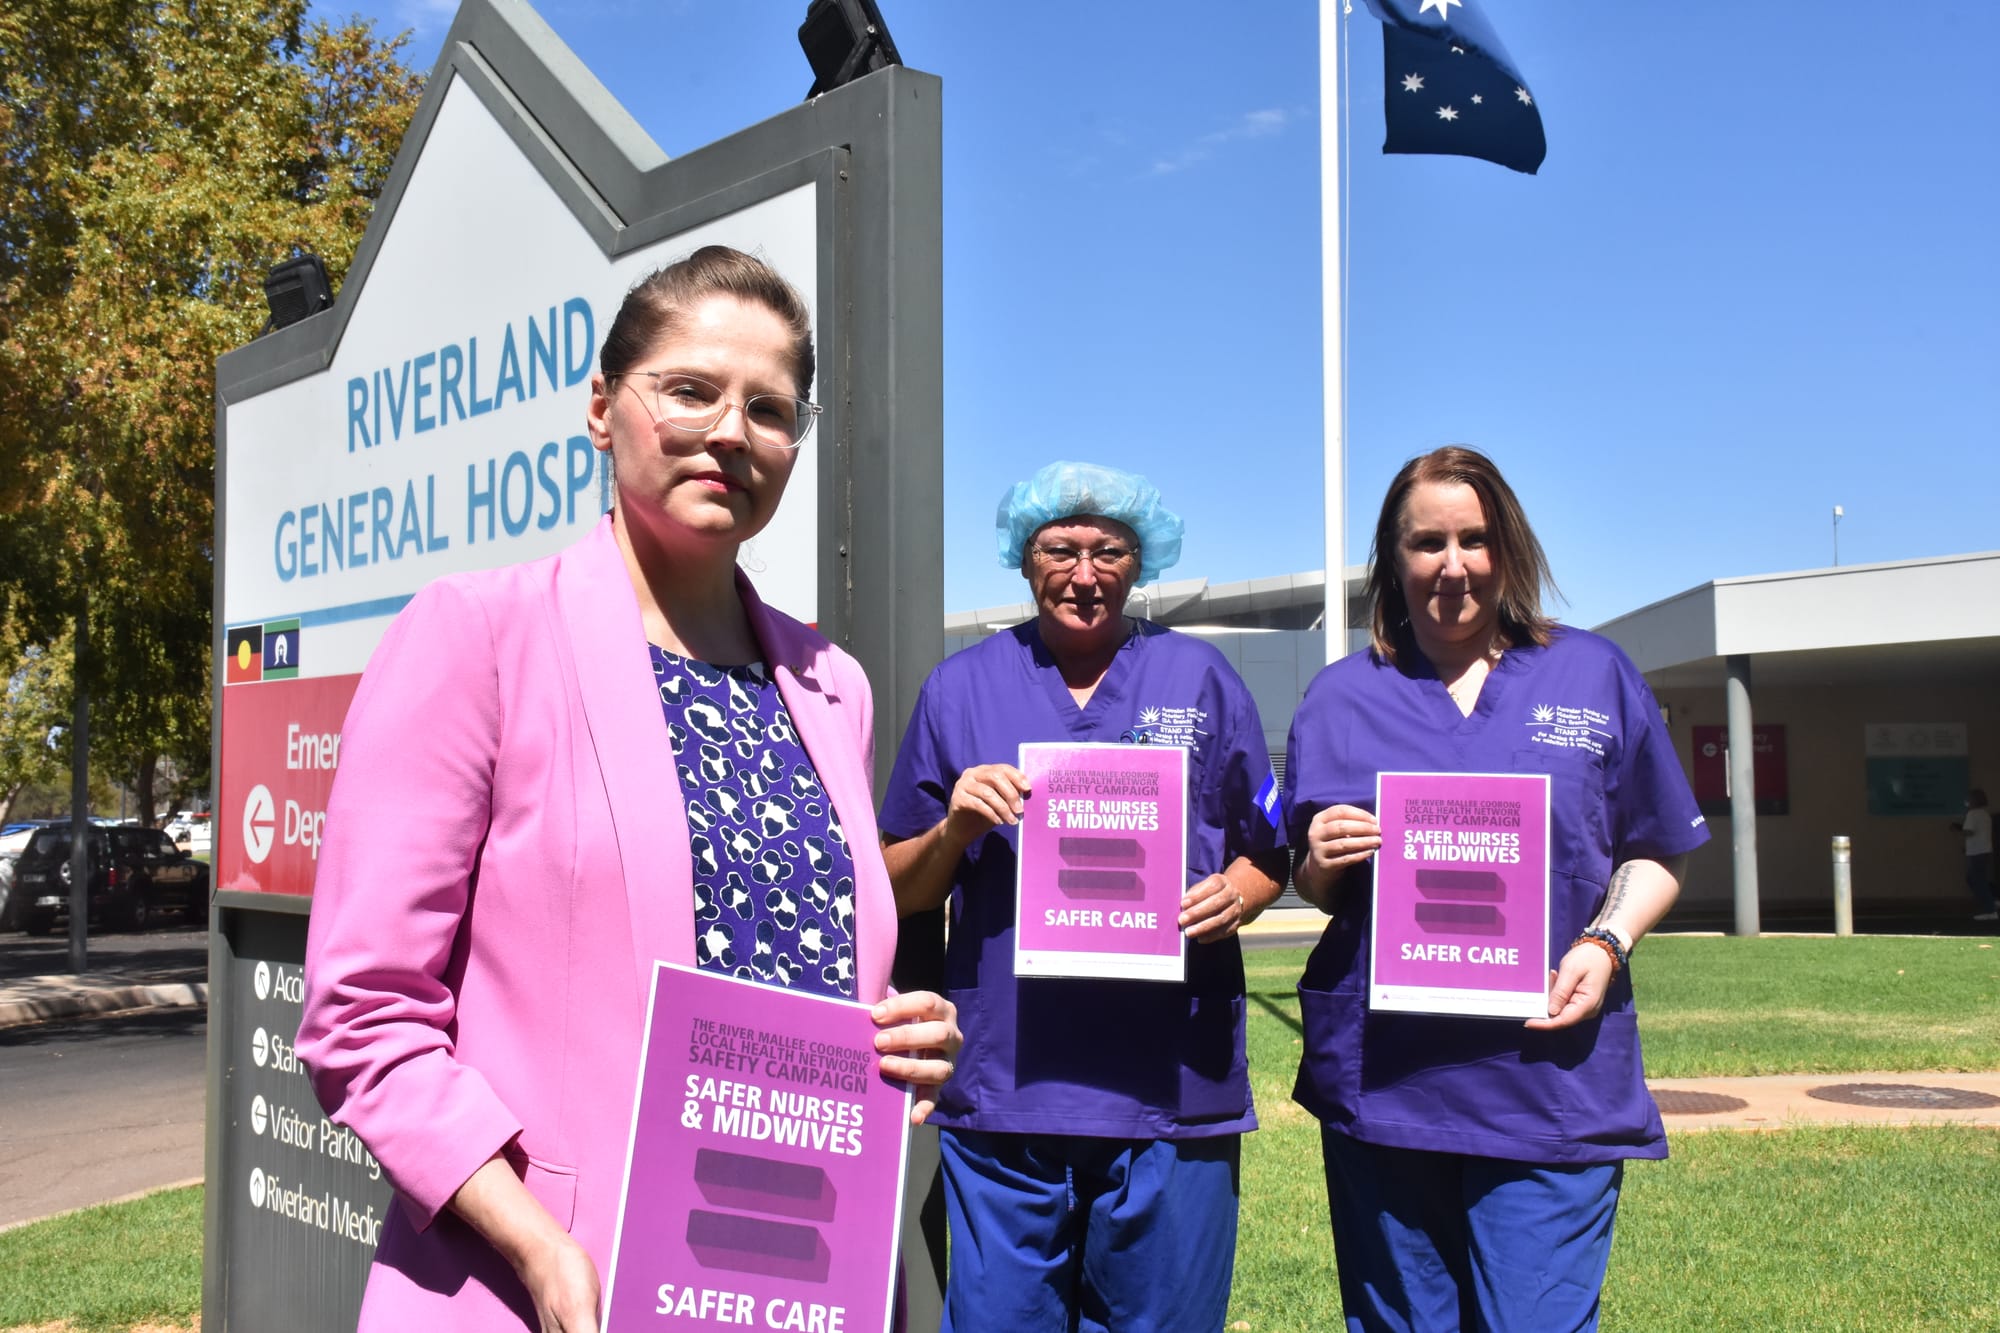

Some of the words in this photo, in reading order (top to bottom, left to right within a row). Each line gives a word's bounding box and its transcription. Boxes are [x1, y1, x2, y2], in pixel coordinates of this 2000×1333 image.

[347, 297, 595, 453] RIVERLAND
[275, 475, 449, 583] GENERAL
[287, 723, 341, 769] Emer
[1048, 776, 1075, 784] LOCAL
[1080, 777, 1111, 785] HEALTH
[1115, 778, 1158, 786] NETWORK
[1048, 784, 1090, 794] SAFETY
[1095, 785, 1159, 796] CAMPAIGN
[1047, 812, 1060, 828] &
[1066, 813, 1159, 831] MIDWIVES
[1048, 799, 1094, 813] SAFER
[1099, 800, 1158, 815] NURSES
[1405, 806, 1433, 814] LOCAL
[1437, 807, 1471, 815] HEALTH
[1474, 808, 1520, 817] NETWORK
[1405, 814, 1449, 825] SAFETY
[1453, 815, 1520, 827] CAMPAIGN
[1403, 844, 1418, 860] &
[1423, 844, 1520, 864] MIDWIVES
[1404, 830, 1453, 844] SAFER
[1458, 831, 1519, 846] NURSES
[1044, 909, 1104, 928] SAFER
[1109, 910, 1158, 929] CARE
[1401, 943, 1462, 964] SAFER
[1467, 946, 1519, 965] CARE
[274, 966, 305, 1003] Acci
[691, 1031, 736, 1051] LOCAL
[741, 1040, 794, 1062] HEALTH
[799, 1052, 867, 1076] NETWORK
[693, 1018, 715, 1033] THE
[718, 1023, 754, 1041] RIVER
[758, 1031, 806, 1050] MALLEE
[809, 1041, 871, 1063] COORONG
[688, 1045, 760, 1074] SAFETY
[765, 1061, 868, 1094] CAMPAIGN
[685, 1074, 762, 1110] SAFER
[769, 1089, 864, 1127] NURSES
[270, 1104, 316, 1150] Visitor
[681, 1099, 703, 1130] &
[712, 1104, 863, 1156] MIDWIVES
[267, 1175, 329, 1230] Riverland
[332, 1197, 382, 1248] Medic
[656, 1283, 755, 1326] SAFER
[765, 1298, 846, 1333] CARE
